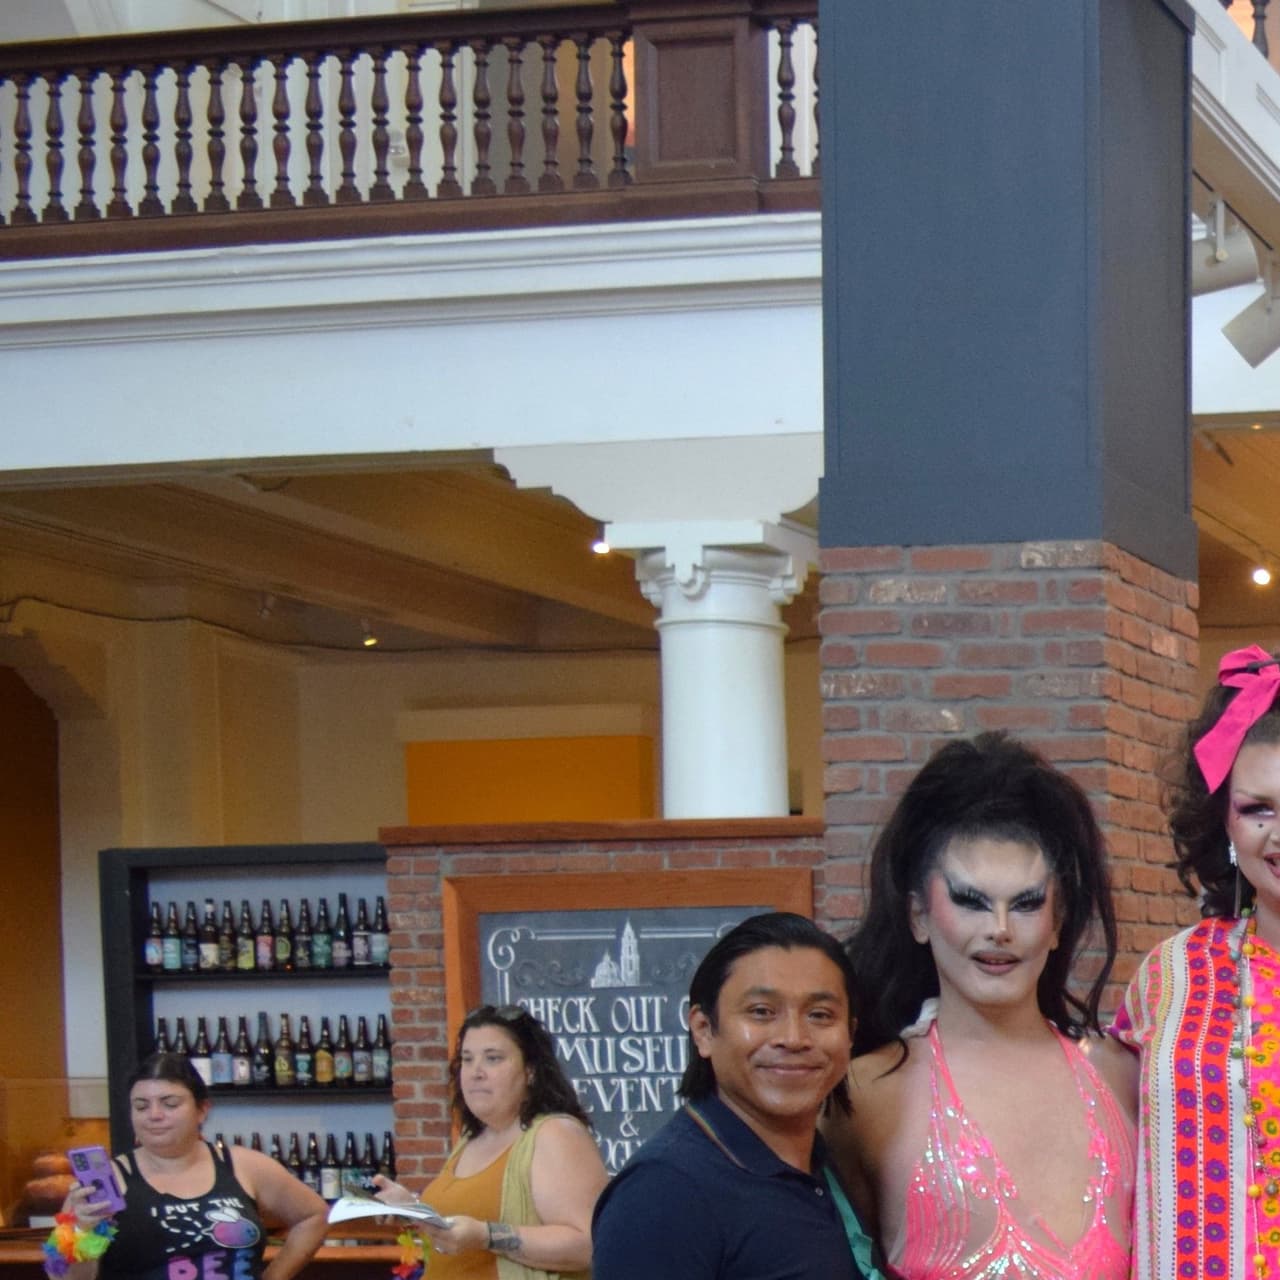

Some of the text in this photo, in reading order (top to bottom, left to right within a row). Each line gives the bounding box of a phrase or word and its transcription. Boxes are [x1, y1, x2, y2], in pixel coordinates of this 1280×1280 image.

[611, 995, 668, 1033] OUT
[556, 1036, 690, 1075] MUSEU
[619, 1112, 640, 1138] &
[164, 1203, 200, 1215] PUT
[208, 1198, 244, 1209] THE
